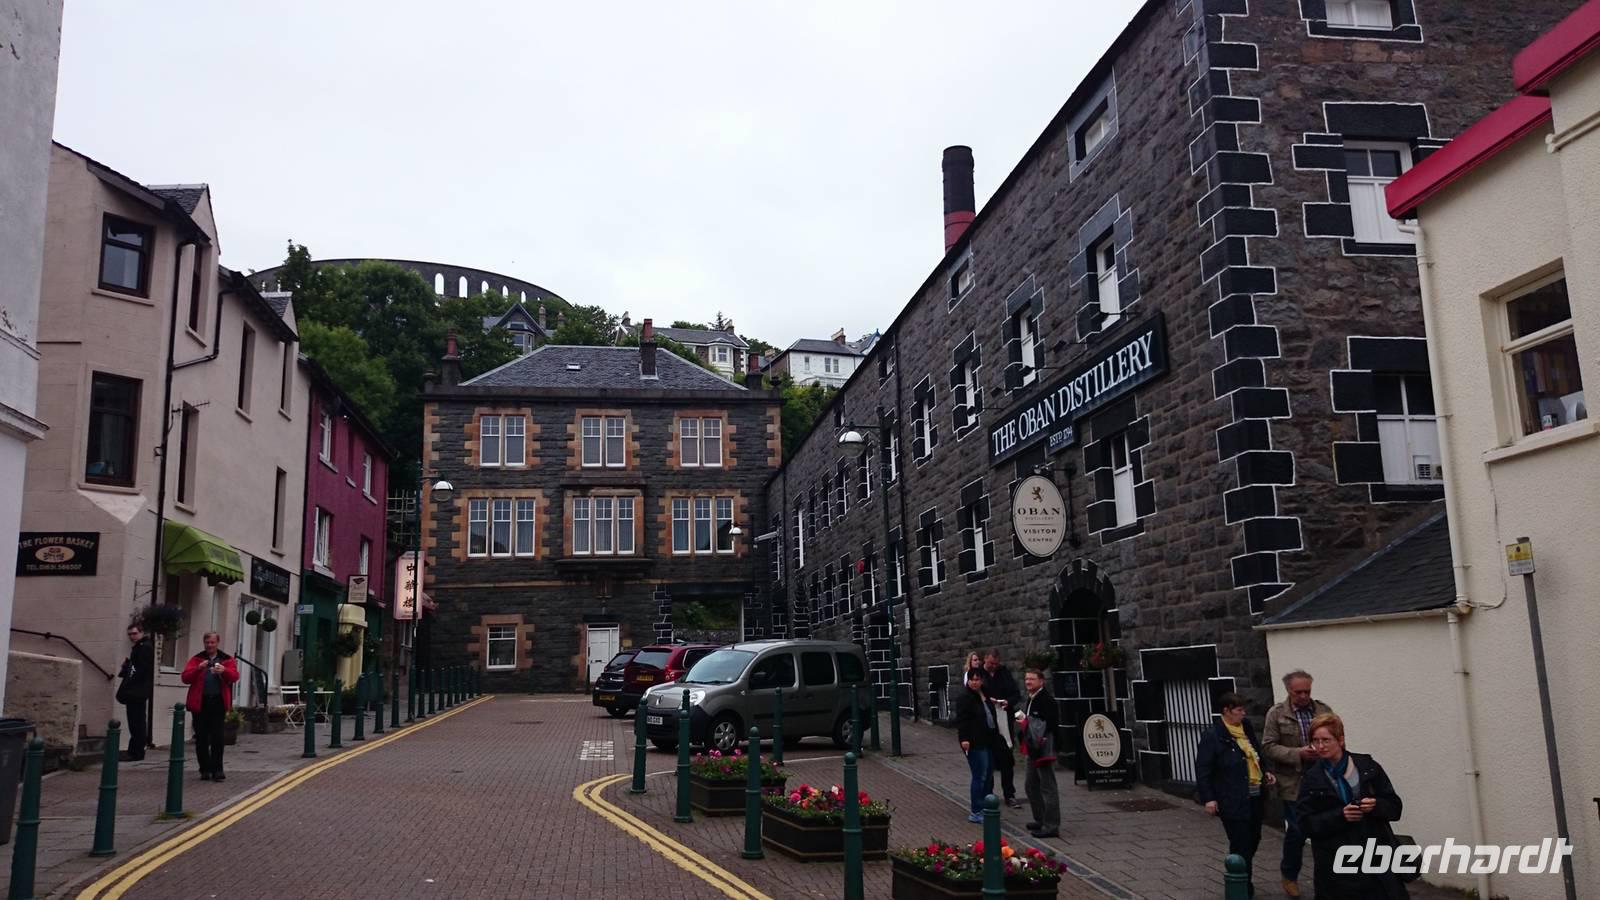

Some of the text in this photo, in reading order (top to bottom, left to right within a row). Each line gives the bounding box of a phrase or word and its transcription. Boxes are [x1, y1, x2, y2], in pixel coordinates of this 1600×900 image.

[992, 330, 1154, 456] THE OBAN DISTILLERY
[1017, 507, 1060, 515] OBAN
[34, 536, 64, 545] FLOWER
[66, 537, 95, 549] BASKET
